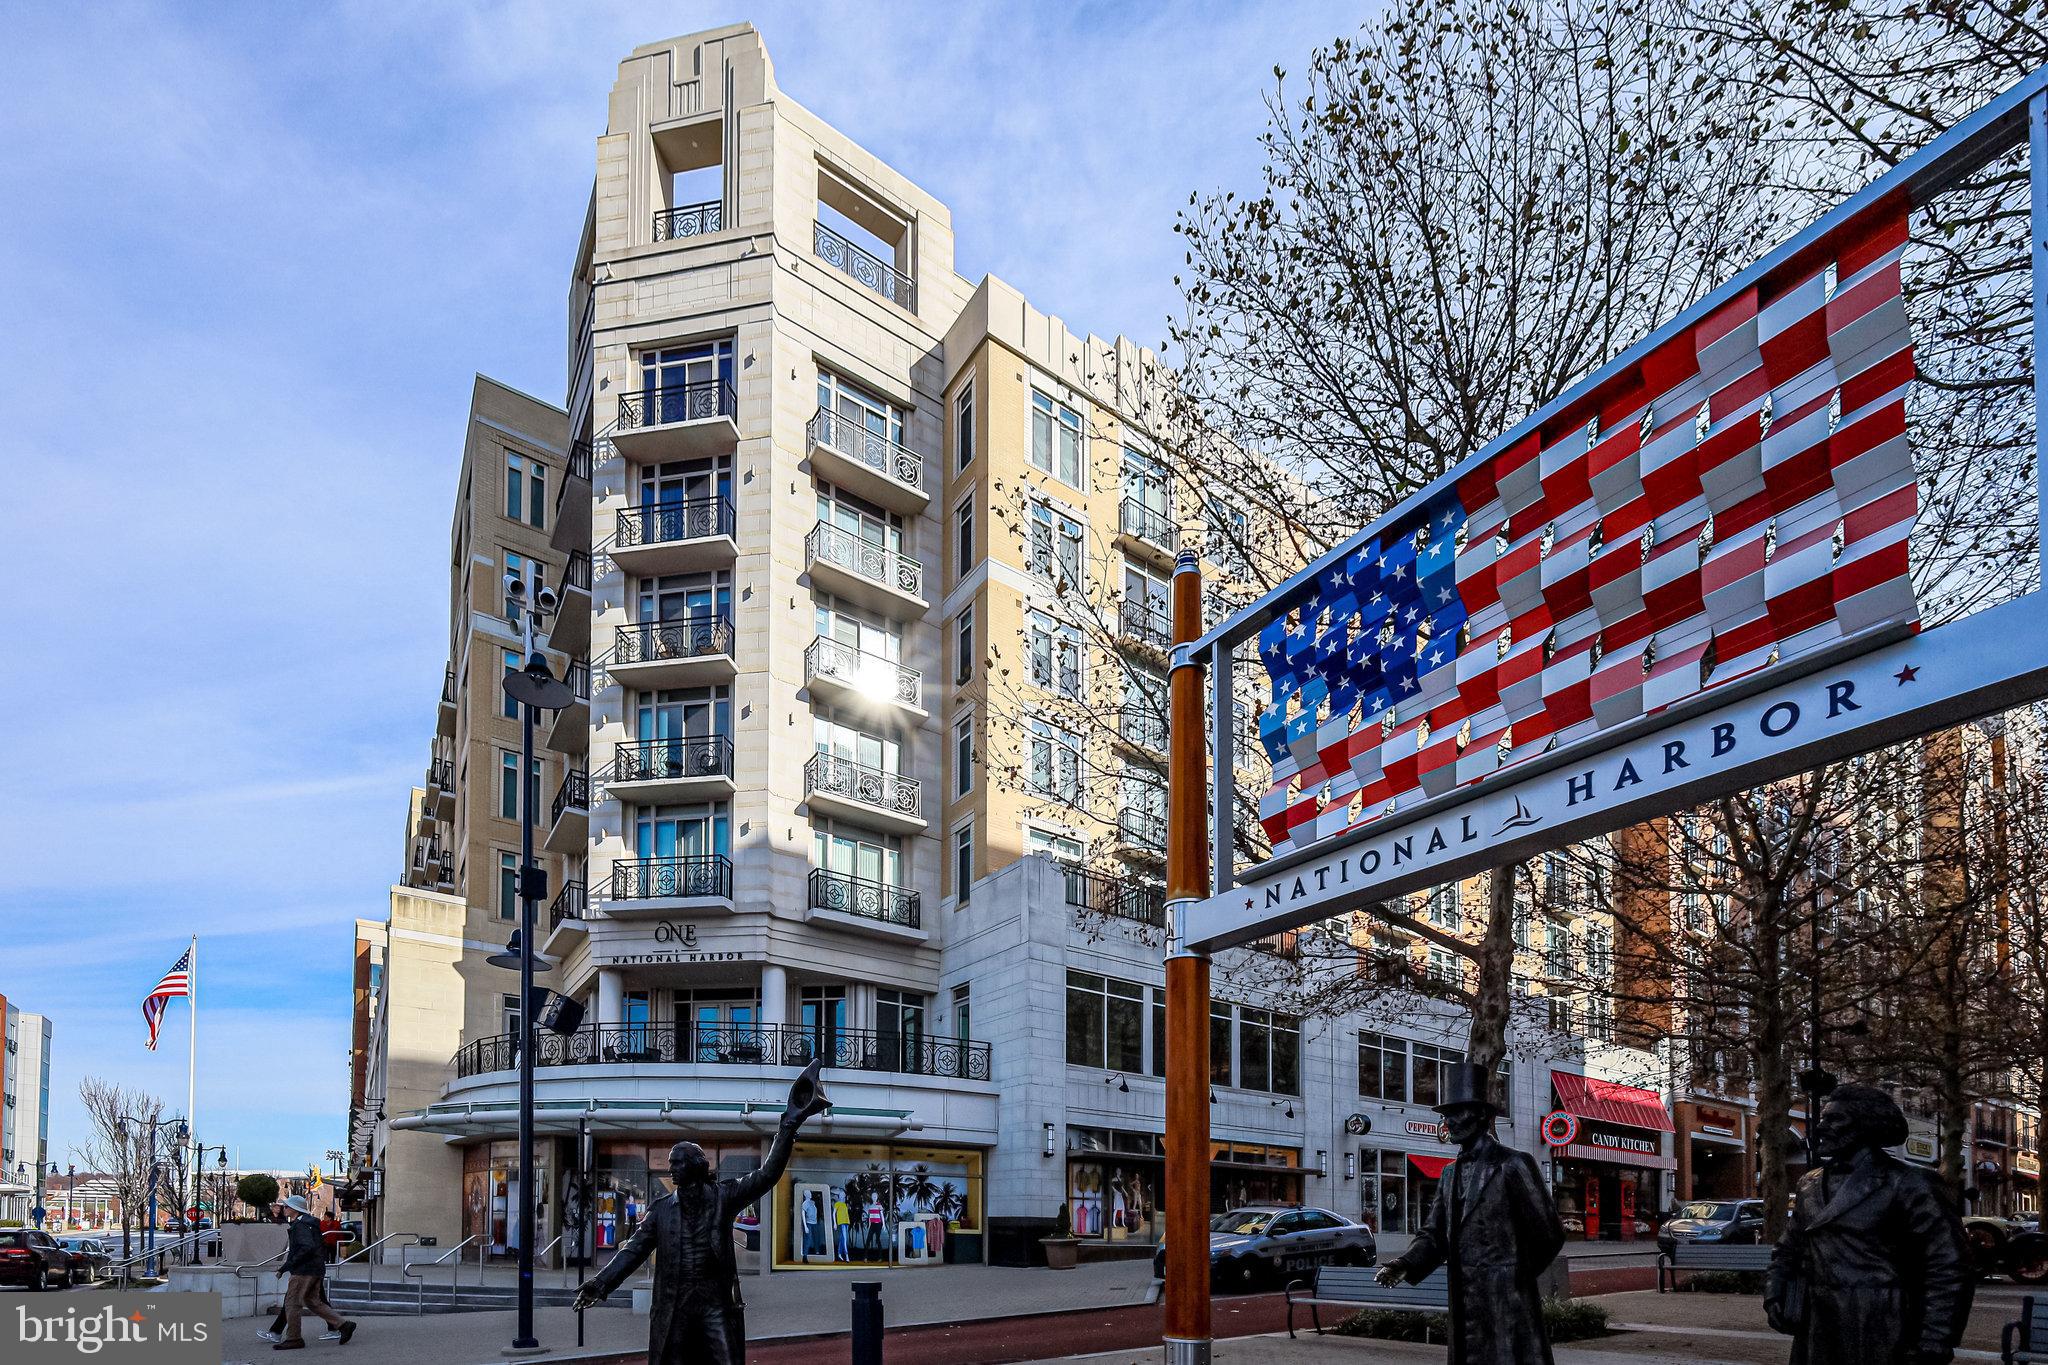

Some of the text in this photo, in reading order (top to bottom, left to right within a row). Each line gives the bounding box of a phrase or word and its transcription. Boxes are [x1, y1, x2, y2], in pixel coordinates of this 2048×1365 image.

[1264, 679, 1862, 909] NATIONAL HARBOR
[654, 920, 698, 947] ONE
[612, 952, 744, 964] NATIONAL HARBOR
[1408, 1121, 1437, 1135] PEPPER
[1592, 1132, 1656, 1153] CANDY KITCHEN
[1286, 1254, 1335, 1272] POLICE
